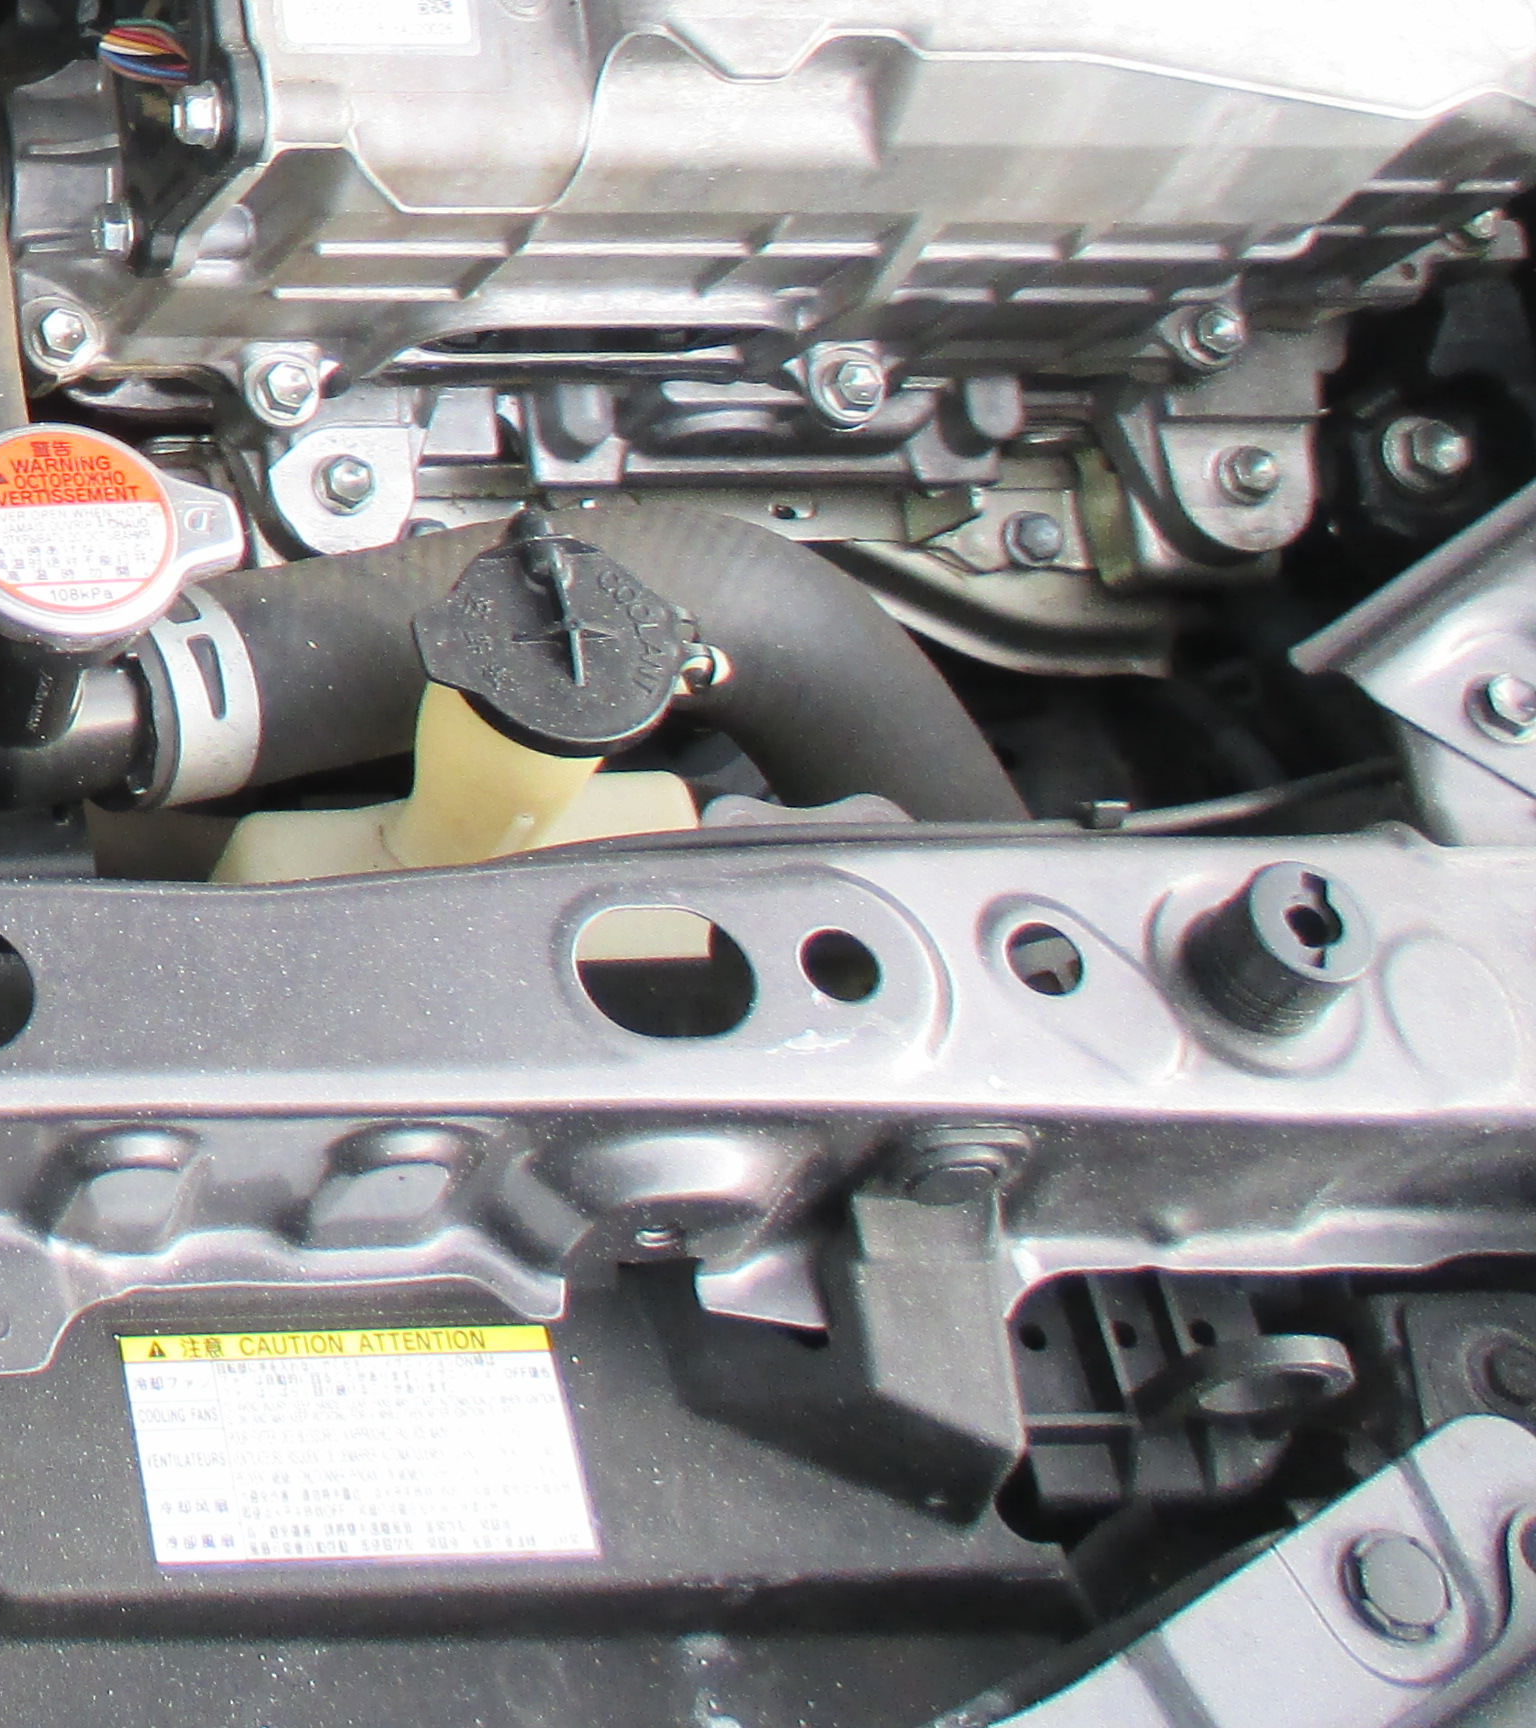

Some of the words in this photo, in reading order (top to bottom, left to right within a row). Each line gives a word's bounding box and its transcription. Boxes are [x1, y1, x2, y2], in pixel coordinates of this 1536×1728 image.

[10, 455, 111, 474] WARNING
[13, 470, 126, 490] ОСТОРОЖНО
[31, 508, 67, 521] OPEN
[73, 506, 112, 519] WHEN
[2, 521, 44, 533] JAMAIS
[49, 518, 92, 531] OUVRIR
[50, 587, 113, 602] 108kPa
[598, 570, 667, 696] COOLANT
[180, 1338, 224, 1359] 注意
[239, 1333, 344, 1357] CAUTION
[359, 1328, 487, 1352] ATTENTION
[138, 1408, 186, 1423] COOLING
[191, 1406, 218, 1421] FANS
[146, 1452, 227, 1468] VENTILATEURS
